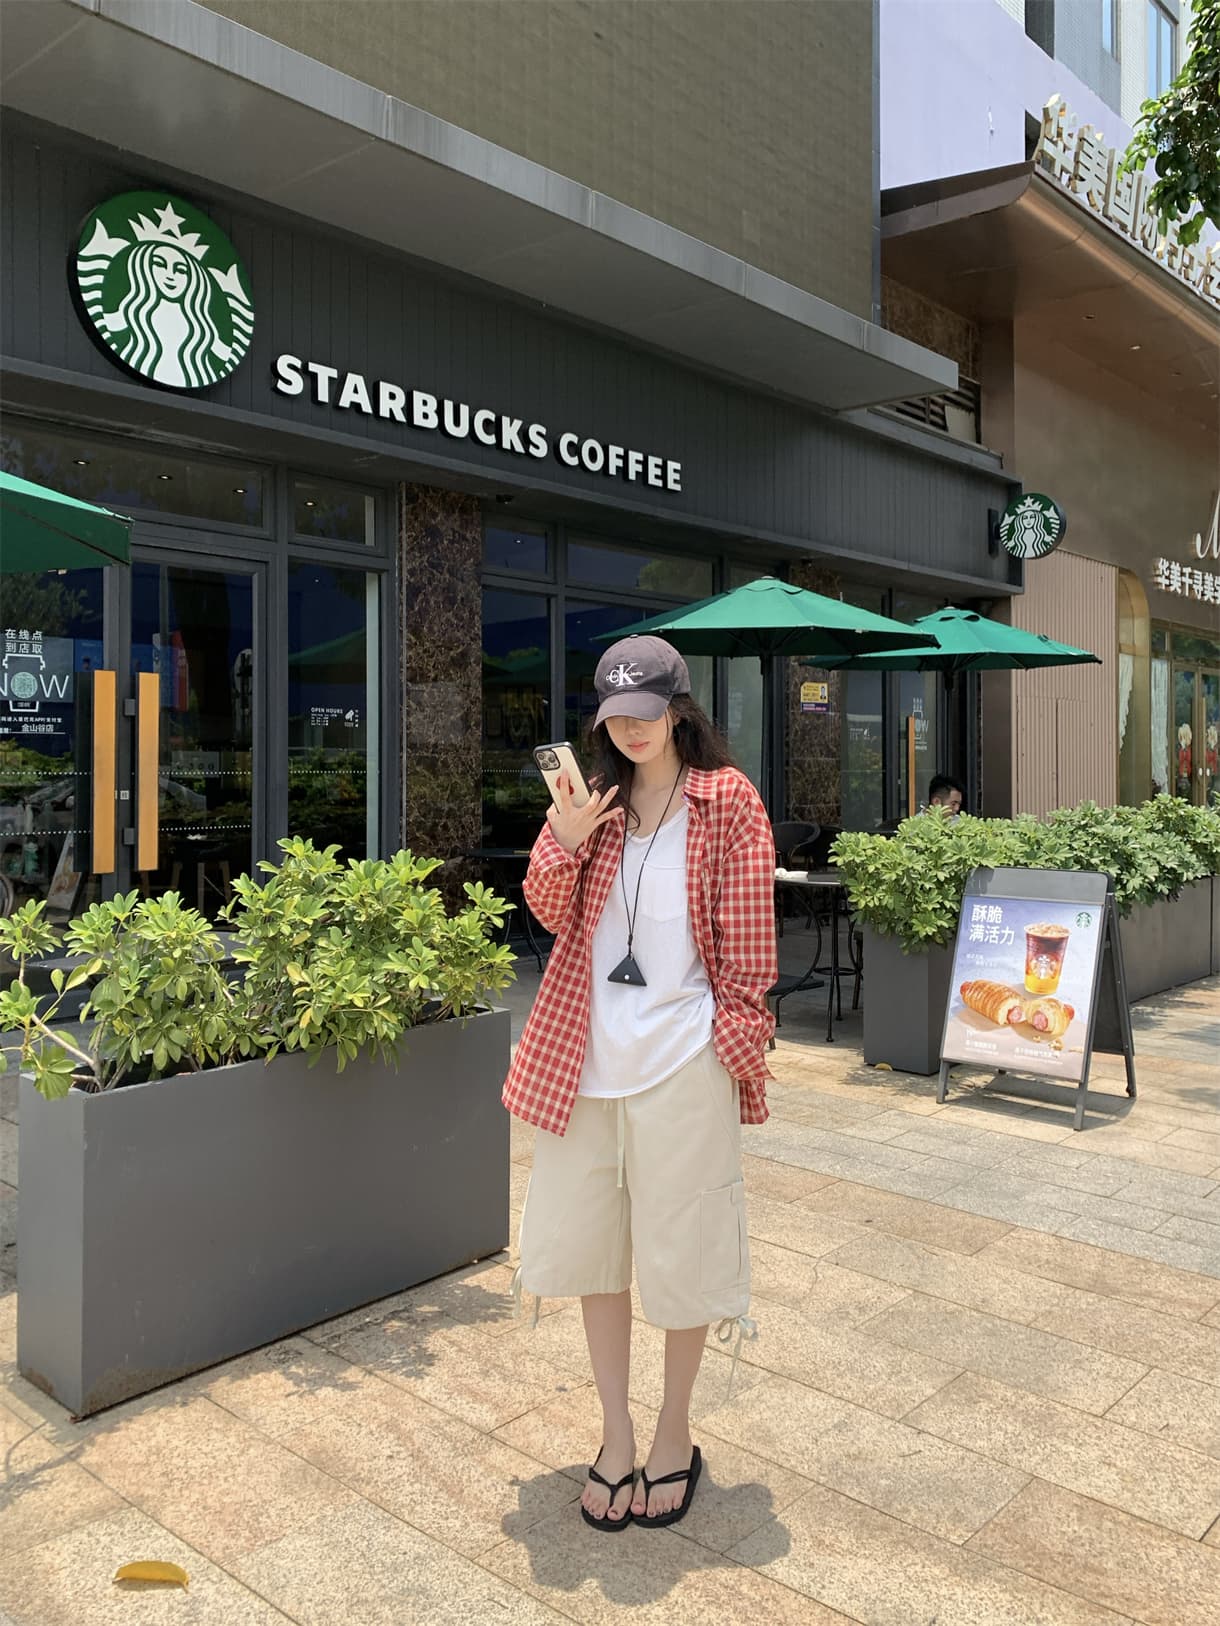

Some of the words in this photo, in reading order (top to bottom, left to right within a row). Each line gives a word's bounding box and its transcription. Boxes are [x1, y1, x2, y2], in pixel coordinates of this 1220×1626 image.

[274, 353, 549, 458] STARBUCKS
[558, 432, 683, 492] COFFEE
[5, 628, 43, 640] 在线点
[5, 642, 43, 654] 到店取
[971, 904, 1003, 924] 酥脆
[969, 924, 1015, 946] 满活力
